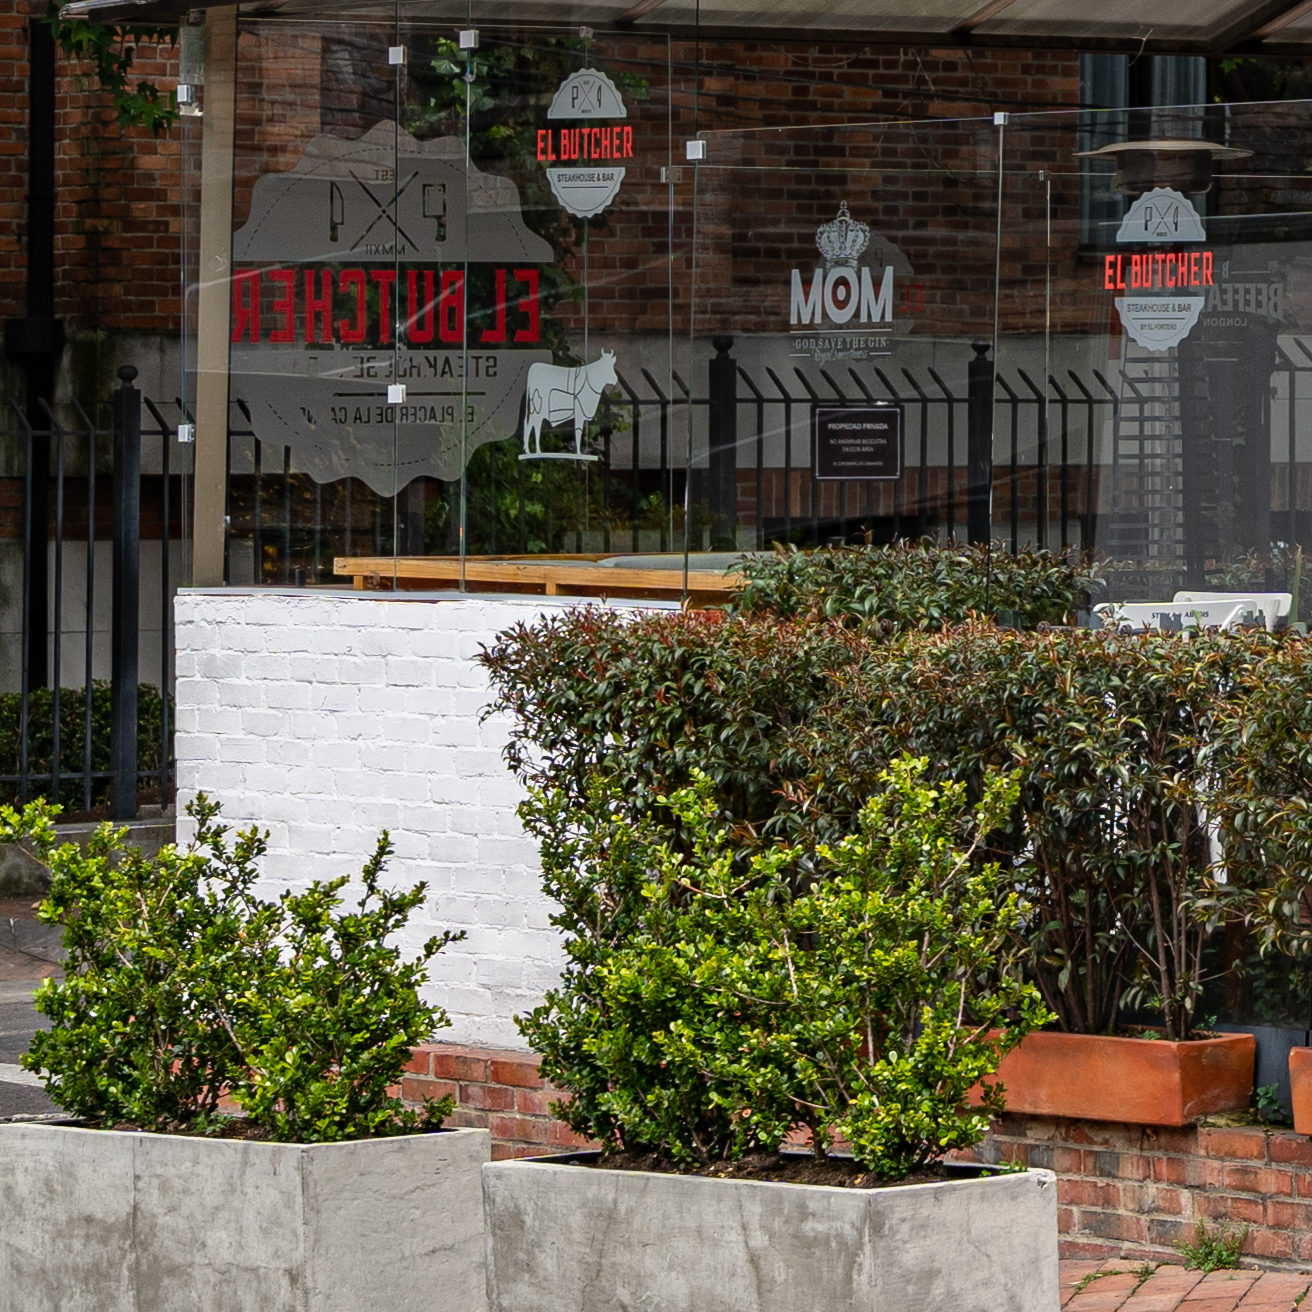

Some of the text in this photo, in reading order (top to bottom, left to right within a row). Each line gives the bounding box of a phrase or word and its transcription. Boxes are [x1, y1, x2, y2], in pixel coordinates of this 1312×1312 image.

[537, 126, 633, 160] EL BUTCHER
[557, 173, 596, 183] STEAKHOUSE
[602, 173, 615, 182] BAR
[1105, 251, 1214, 290] EL BUTCHER
[790, 266, 894, 325] MOM
[1127, 303, 1170, 313] STEAKHOUSE
[1177, 303, 1192, 313] BAR
[818, 337, 843, 349] SAVE
[845, 337, 866, 348] THE
